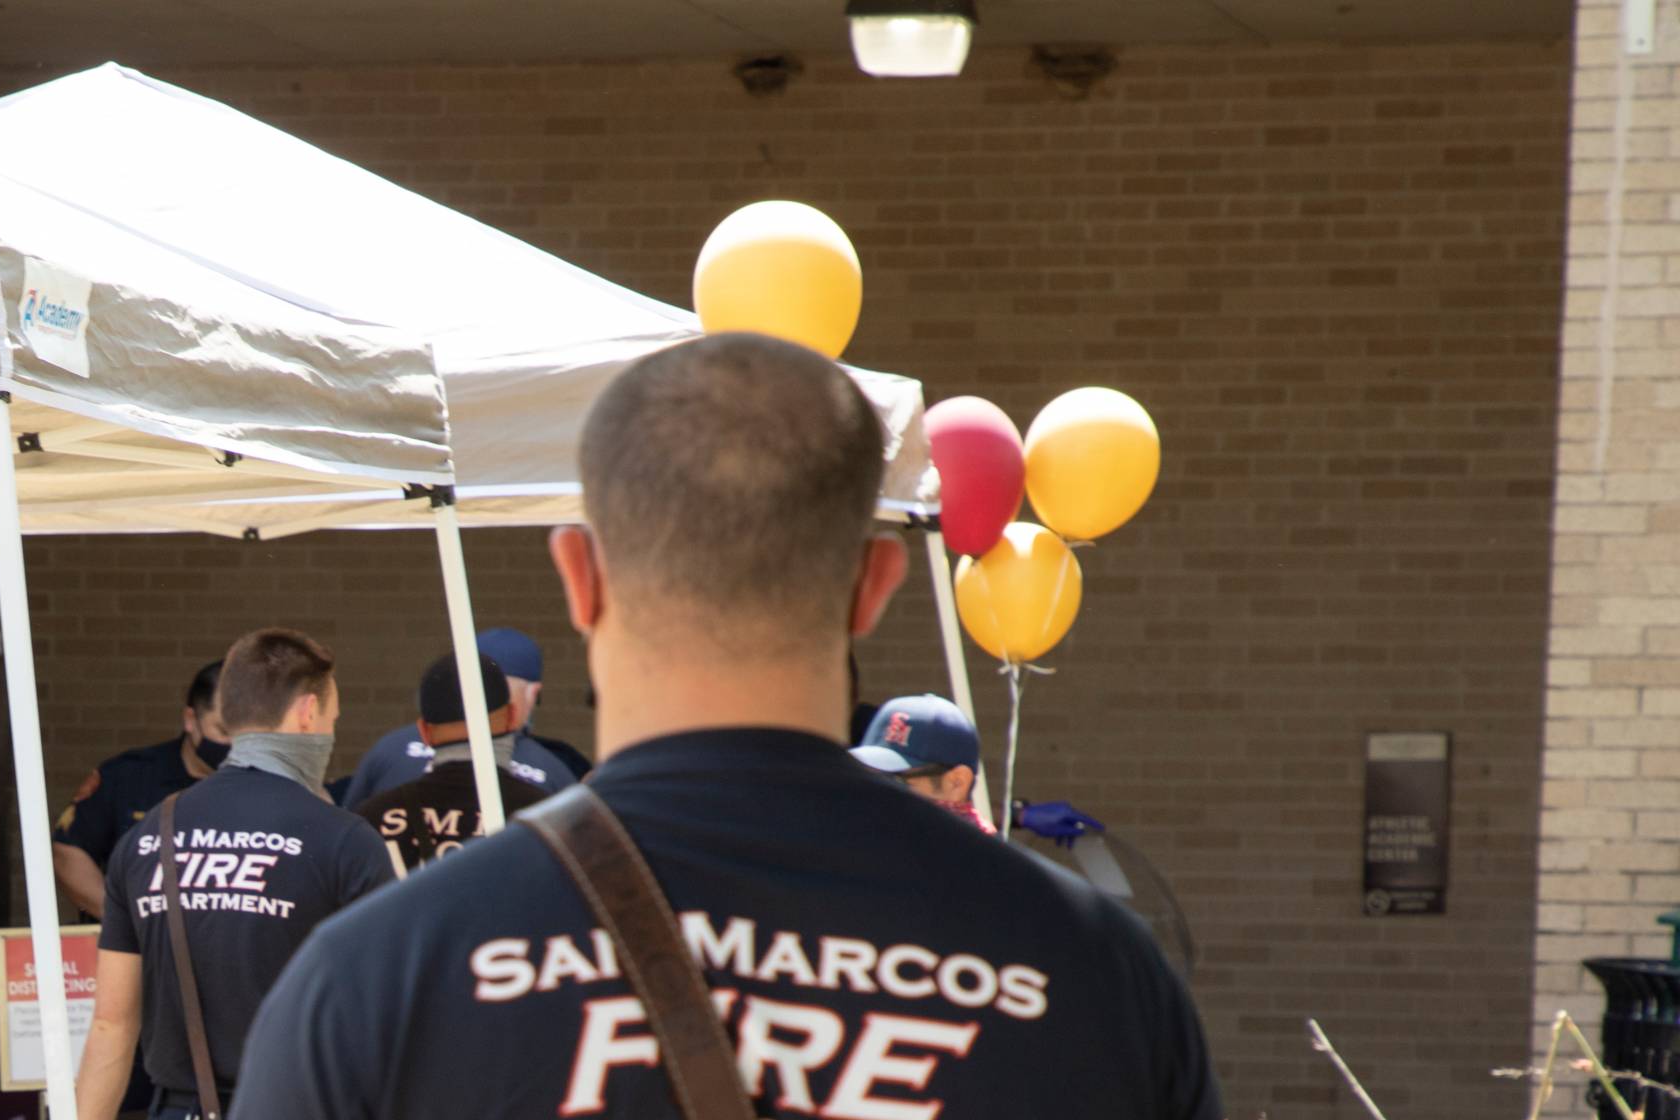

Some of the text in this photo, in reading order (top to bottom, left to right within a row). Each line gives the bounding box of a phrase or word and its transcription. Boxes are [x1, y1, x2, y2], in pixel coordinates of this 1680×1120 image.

[190, 828, 303, 855] MARCOS
[24, 961, 79, 976] SAL
[677, 910, 1049, 1020] MARCOS
[8, 977, 96, 996] DISTCING
